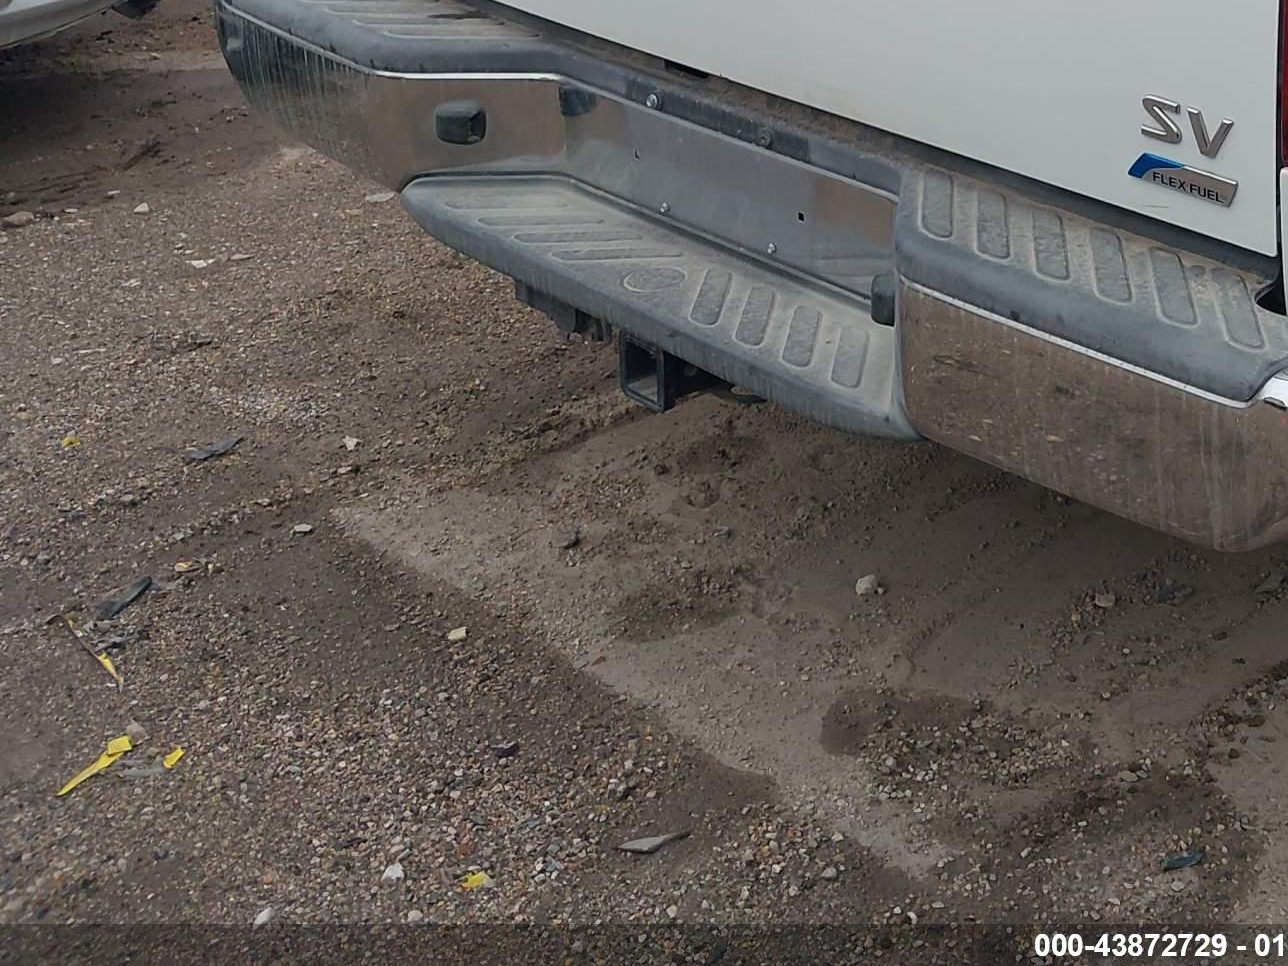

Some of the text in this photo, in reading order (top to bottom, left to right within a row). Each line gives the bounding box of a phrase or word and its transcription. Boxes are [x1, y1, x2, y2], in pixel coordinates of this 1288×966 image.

[1140, 93, 1234, 160] SV
[1152, 171, 1224, 204] FLEX FUEL
